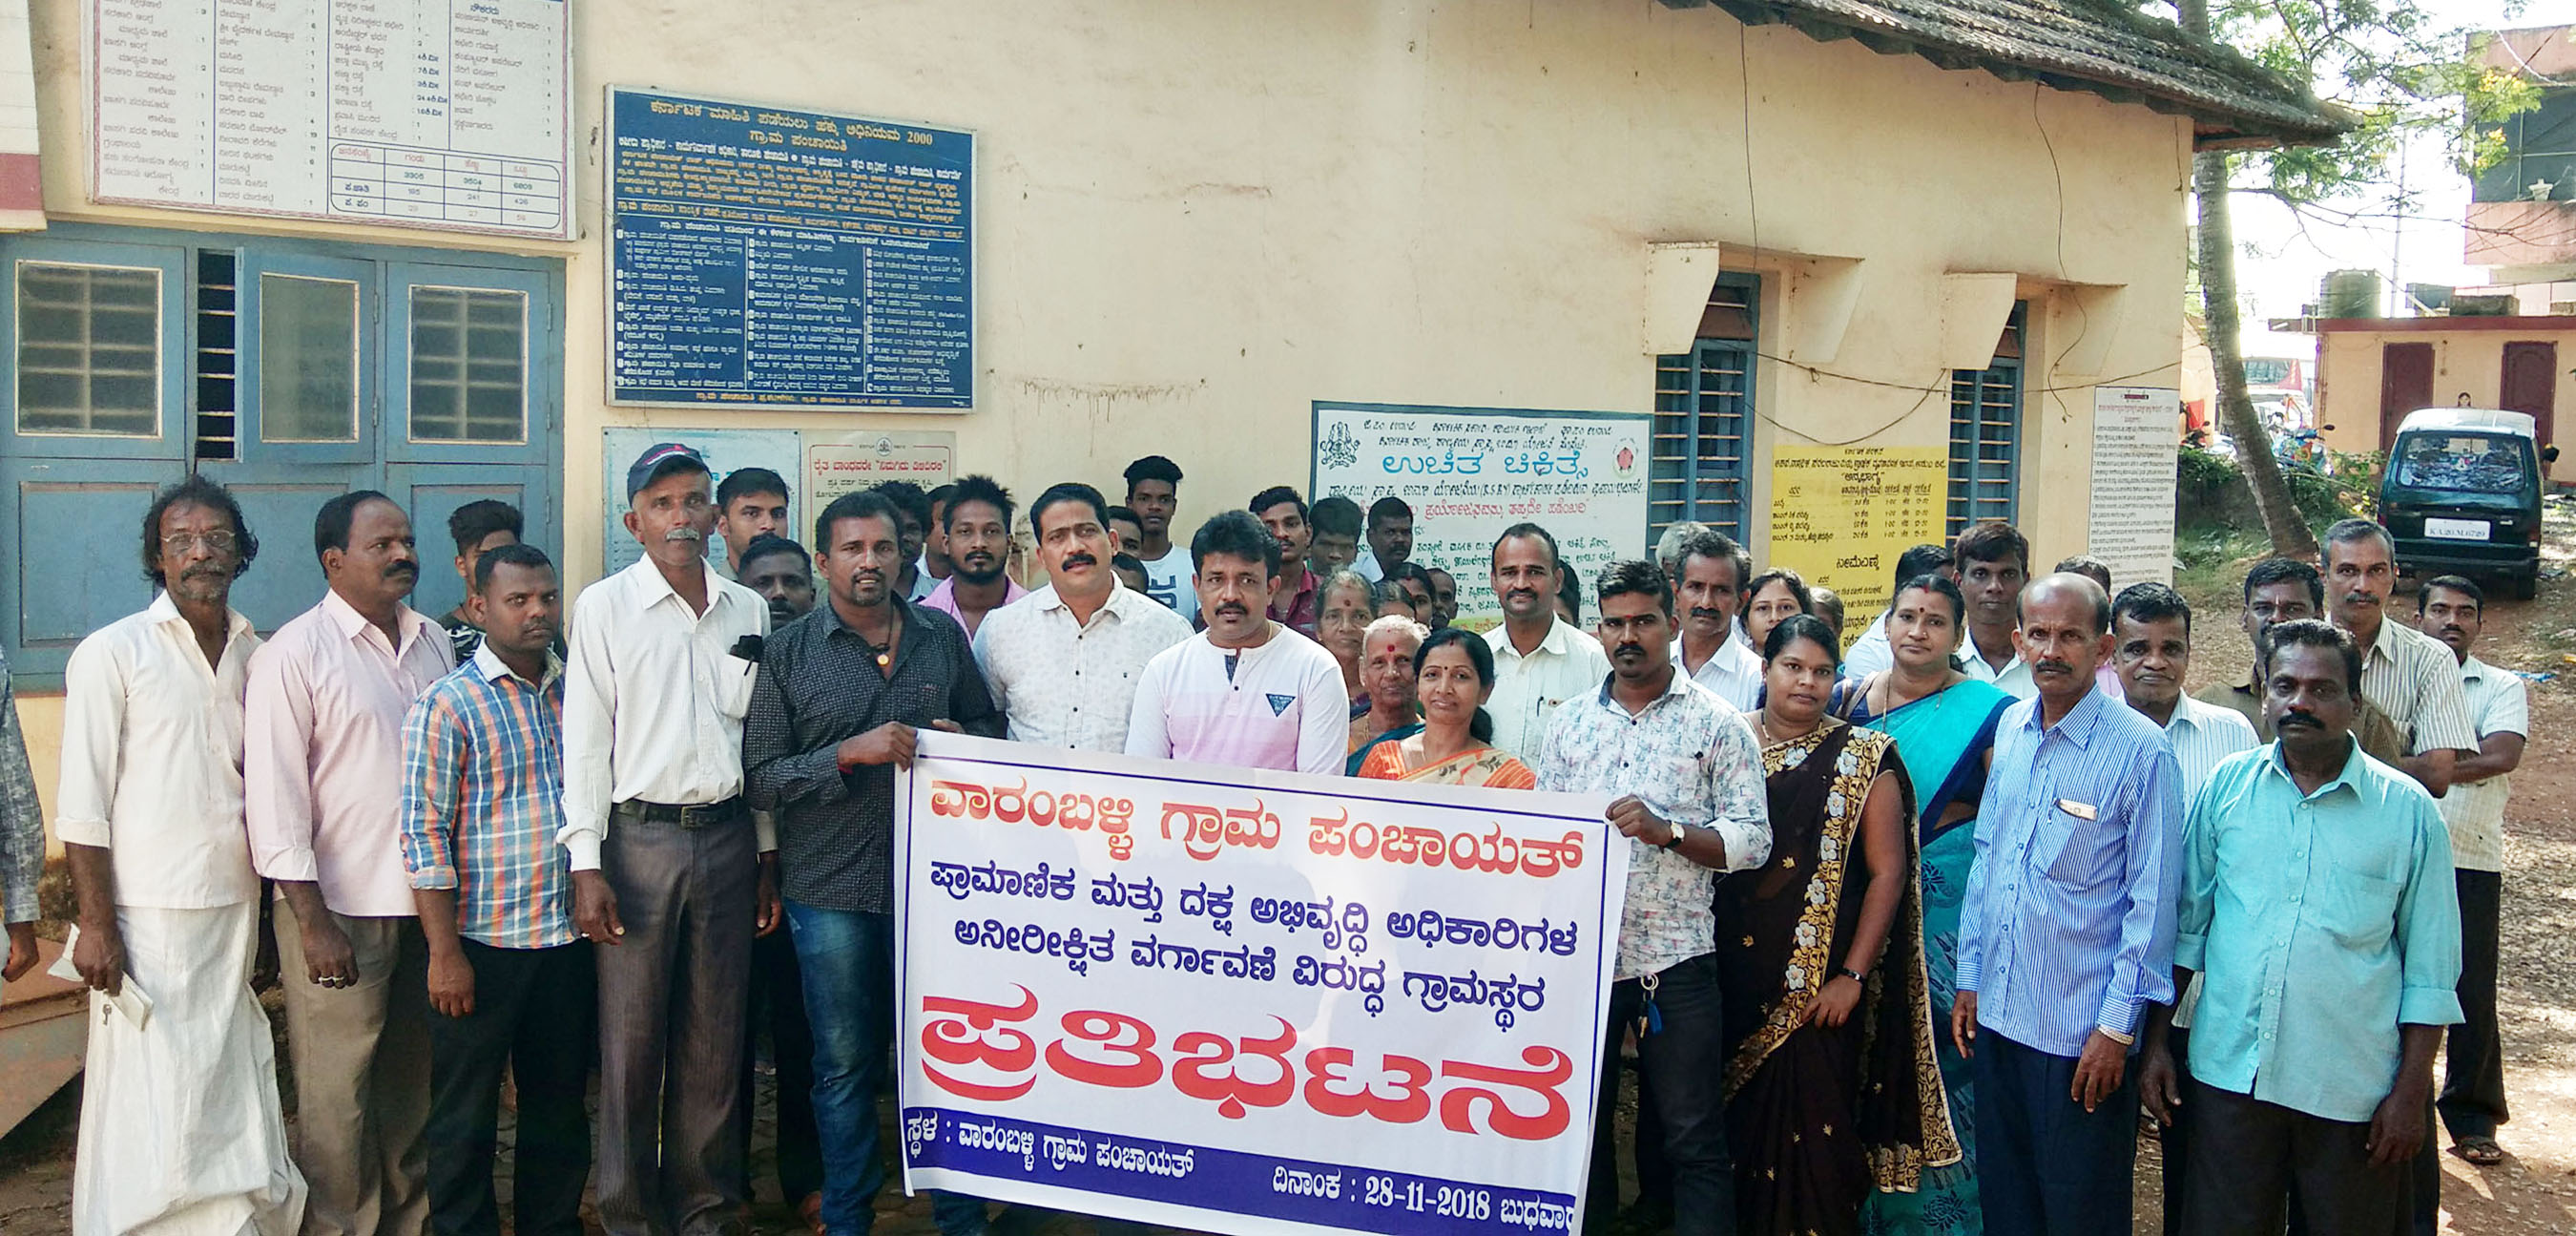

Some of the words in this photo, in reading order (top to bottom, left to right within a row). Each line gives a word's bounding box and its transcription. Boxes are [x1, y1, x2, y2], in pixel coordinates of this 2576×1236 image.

[907, 131, 933, 145] 2000
[1382, 450, 1484, 474] ಉಚಿತ
[1505, 450, 1589, 479] ಚಿಕಿತ್ಸೆ
[930, 775, 1134, 860] ವಾರಂಬಳ್ಳಿ
[1160, 798, 1280, 861] ಗ್ರಾಮ
[1309, 807, 1585, 878] ಪಂಚಾಯತ್
[930, 860, 1075, 900] ಪ್ರಾಮಾಣಿಕ
[1091, 872, 1163, 923] ಮತ್ತು
[1179, 881, 1234, 936] ದಕ್ಷ
[1250, 896, 1370, 956] ಅಭಿವೃದ್ಧಿ
[1386, 909, 1578, 956] ಅಧಿಕಾರಿಗಳ
[954, 918, 1114, 976] ಅನೀರೀಕ್ಷಿತ
[1131, 933, 1277, 981] ವರ್ಗಾವಣೆ
[1293, 954, 1385, 1017] ವಿರುದ್ಧ
[1402, 975, 1545, 1032] ಗ್ರಾಮಸ್ಥರ
[921, 982, 1573, 1142] ಪ್ರತಿಭಟನೆ
[907, 1111, 938, 1159] ಸ್ಥಳ
[958, 1120, 1035, 1172] ವಾರಂಬಳ್ಳಿ
[1043, 1133, 1088, 1170] ಗ್ರಾಮ
[1096, 1138, 1195, 1178] ಪಂಚಾಯತ್
[1272, 1165, 1342, 1199] ದಿನಾಂಕ
[1364, 1175, 1490, 1221] 28-11-2018
